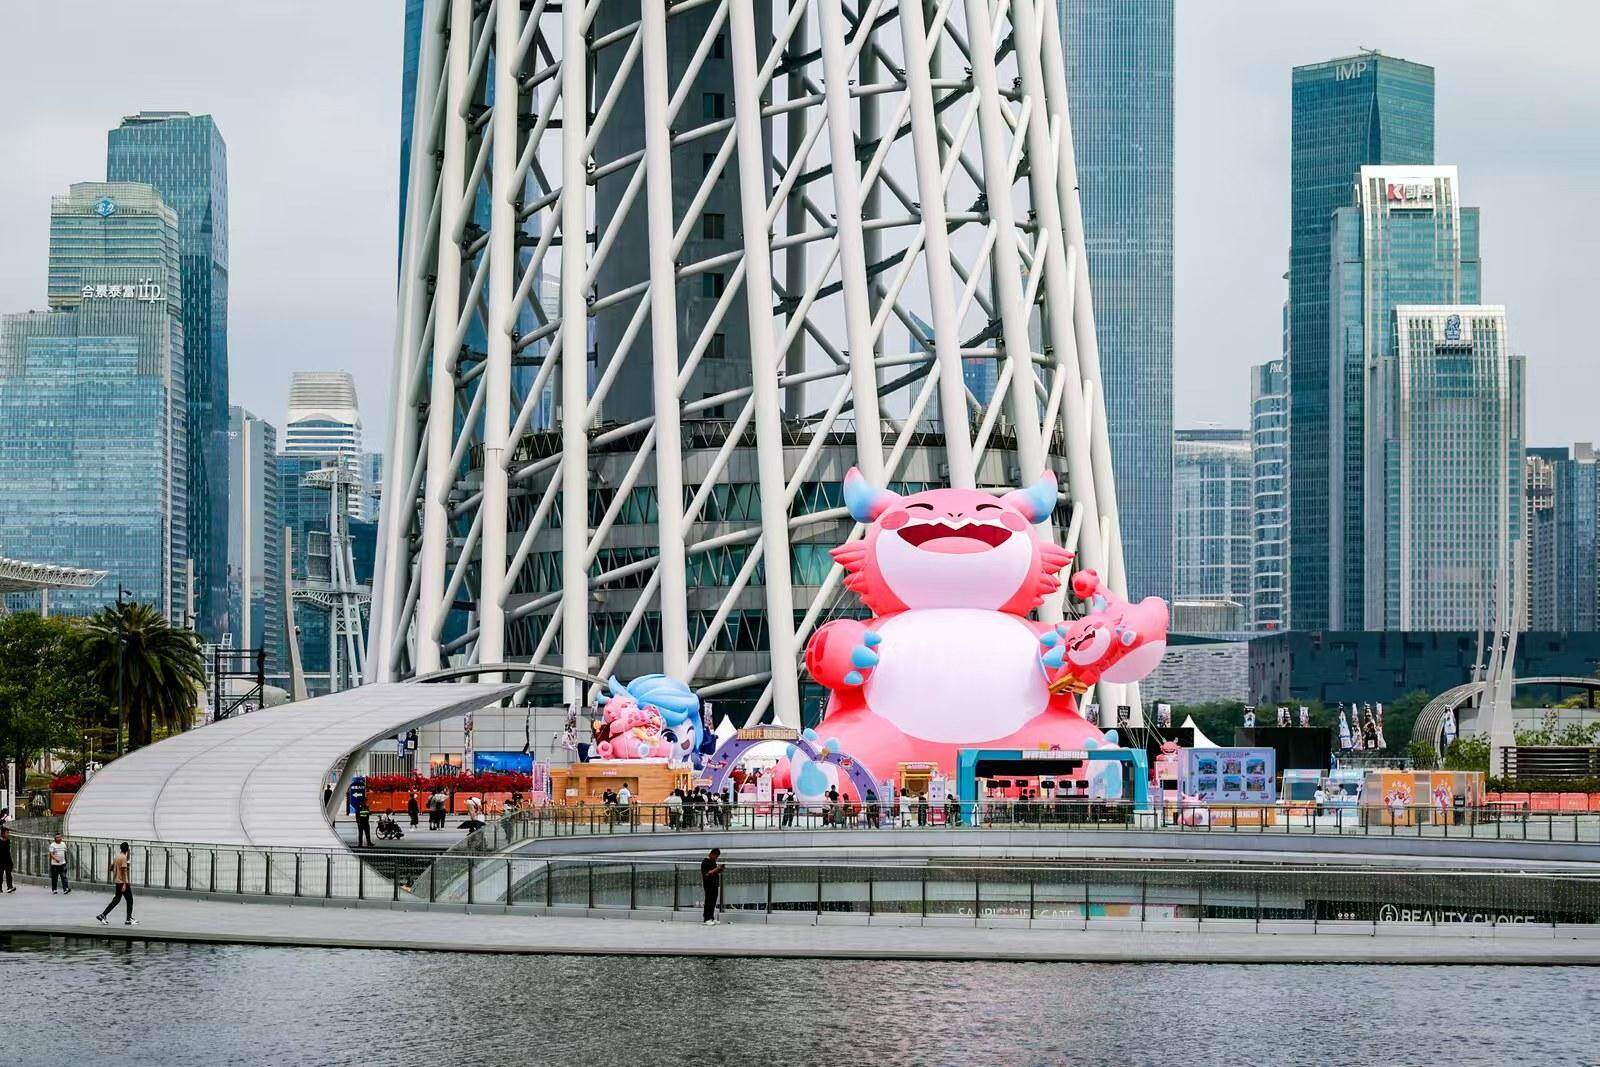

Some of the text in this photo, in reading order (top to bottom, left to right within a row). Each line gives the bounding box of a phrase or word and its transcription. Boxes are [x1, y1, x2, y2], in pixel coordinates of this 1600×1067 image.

[1336, 61, 1367, 82] IMP
[81, 278, 161, 304] 合景泰富 ifp
[1401, 909, 1468, 923] BEAUTY
